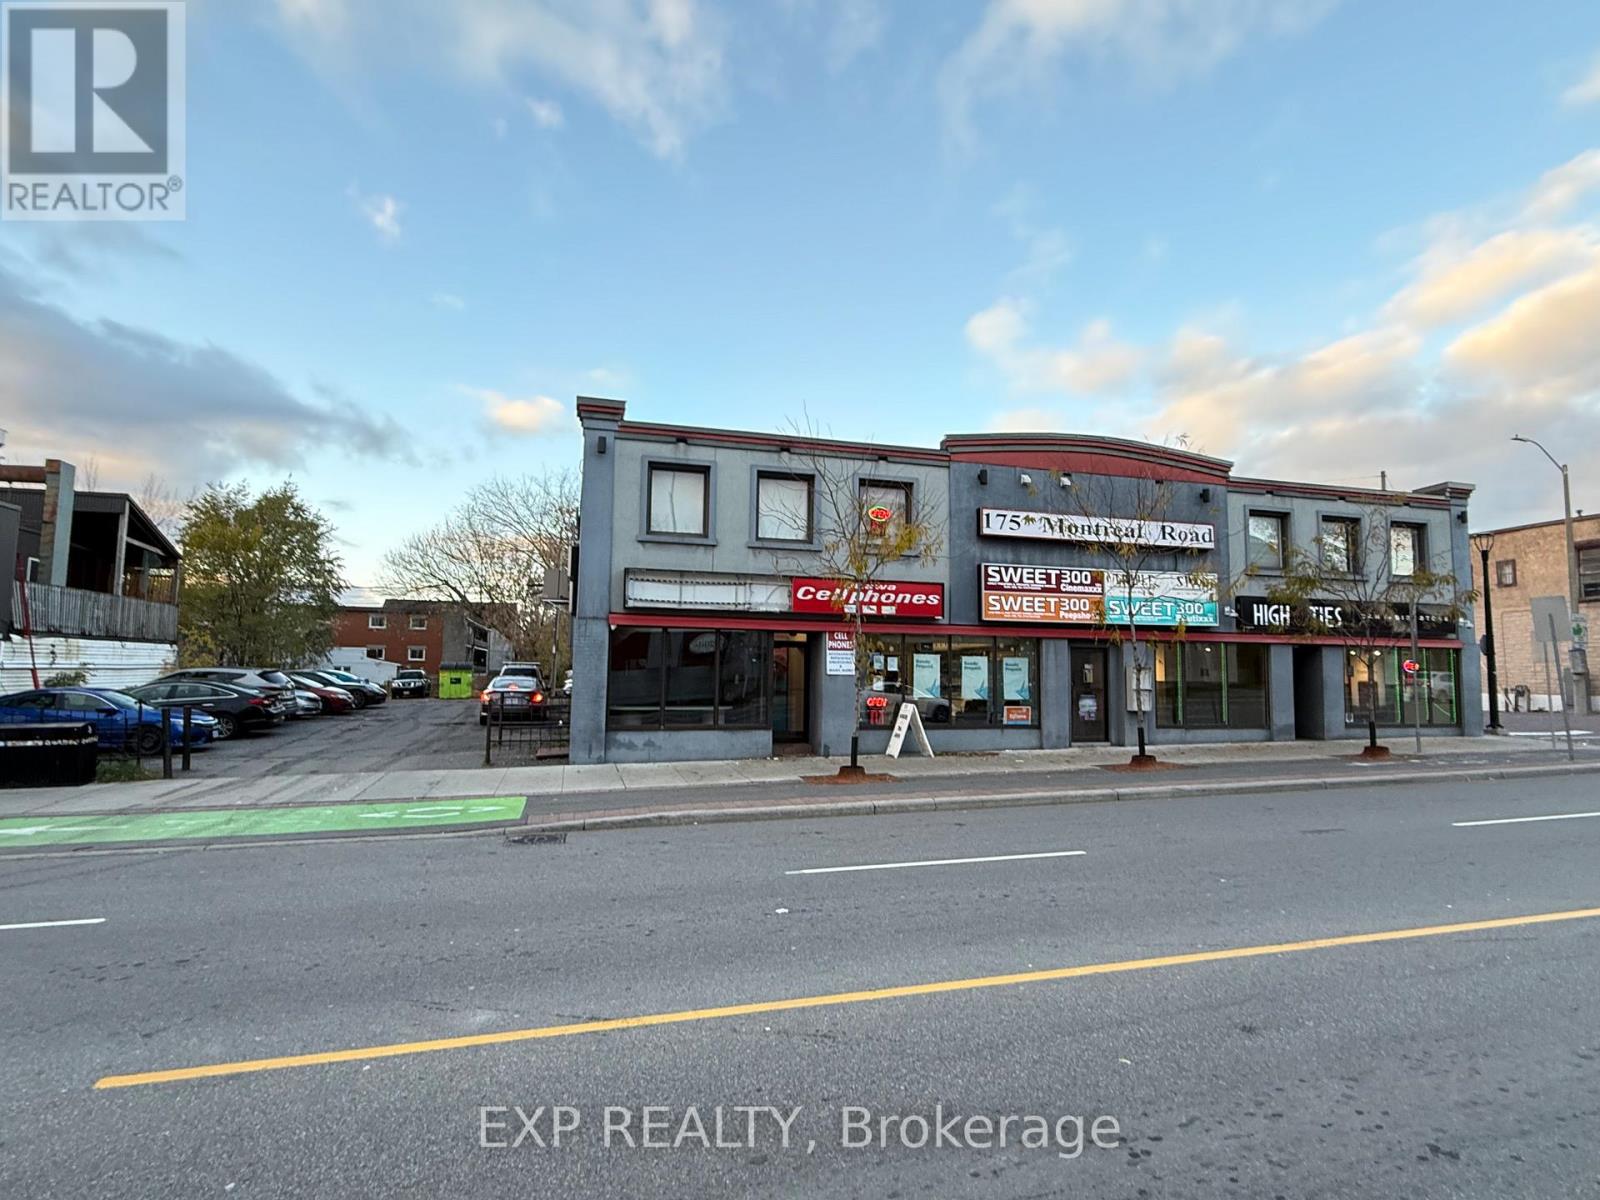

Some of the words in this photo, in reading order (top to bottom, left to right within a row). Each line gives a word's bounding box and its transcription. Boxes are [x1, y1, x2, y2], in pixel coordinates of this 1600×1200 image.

[984, 511, 1021, 532] 175
[1161, 525, 1214, 544] Road
[1252, 603, 1290, 626] HIGH
[833, 631, 848, 640] CELL
[866, 696, 889, 707] OPEN
